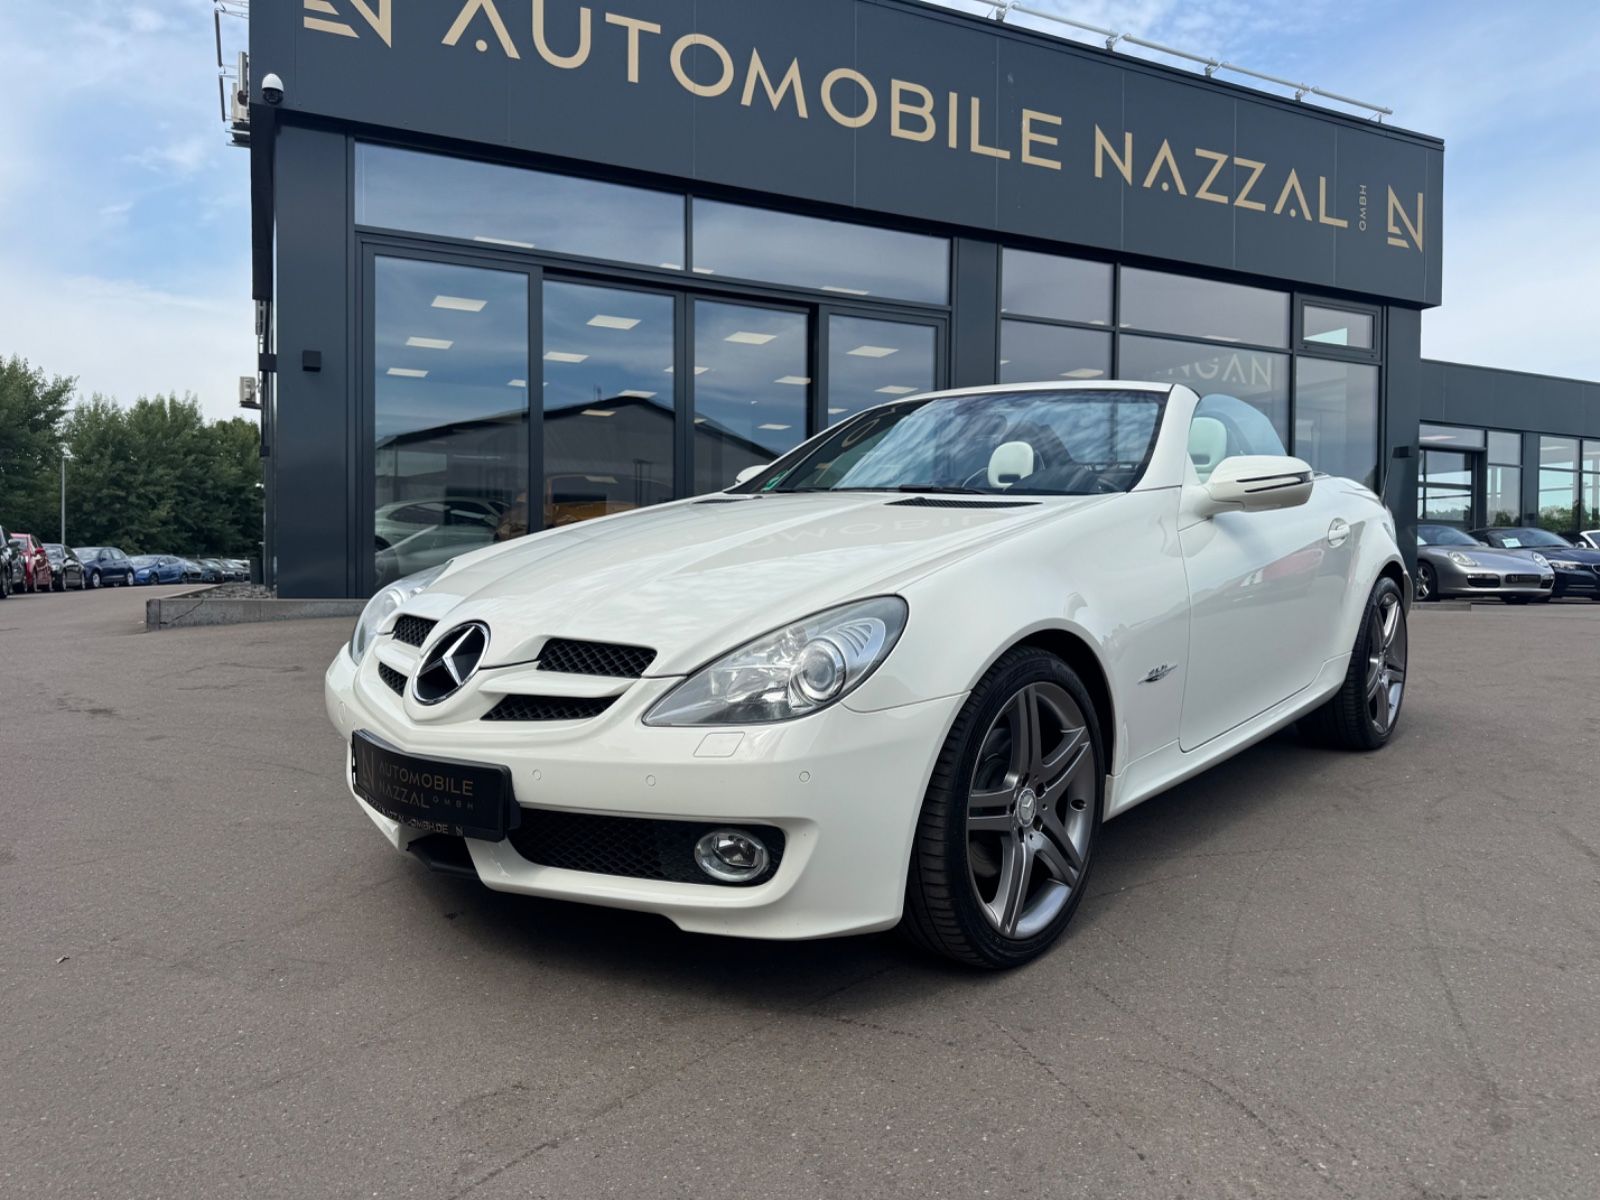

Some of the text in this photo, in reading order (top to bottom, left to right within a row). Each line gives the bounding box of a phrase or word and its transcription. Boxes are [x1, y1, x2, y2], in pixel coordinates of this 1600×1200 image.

[441, 0, 1349, 229] AUTOMOBILE NAZZAL
[378, 760, 474, 797] AUTOMOBILE
[379, 779, 431, 809] NAZZAL
